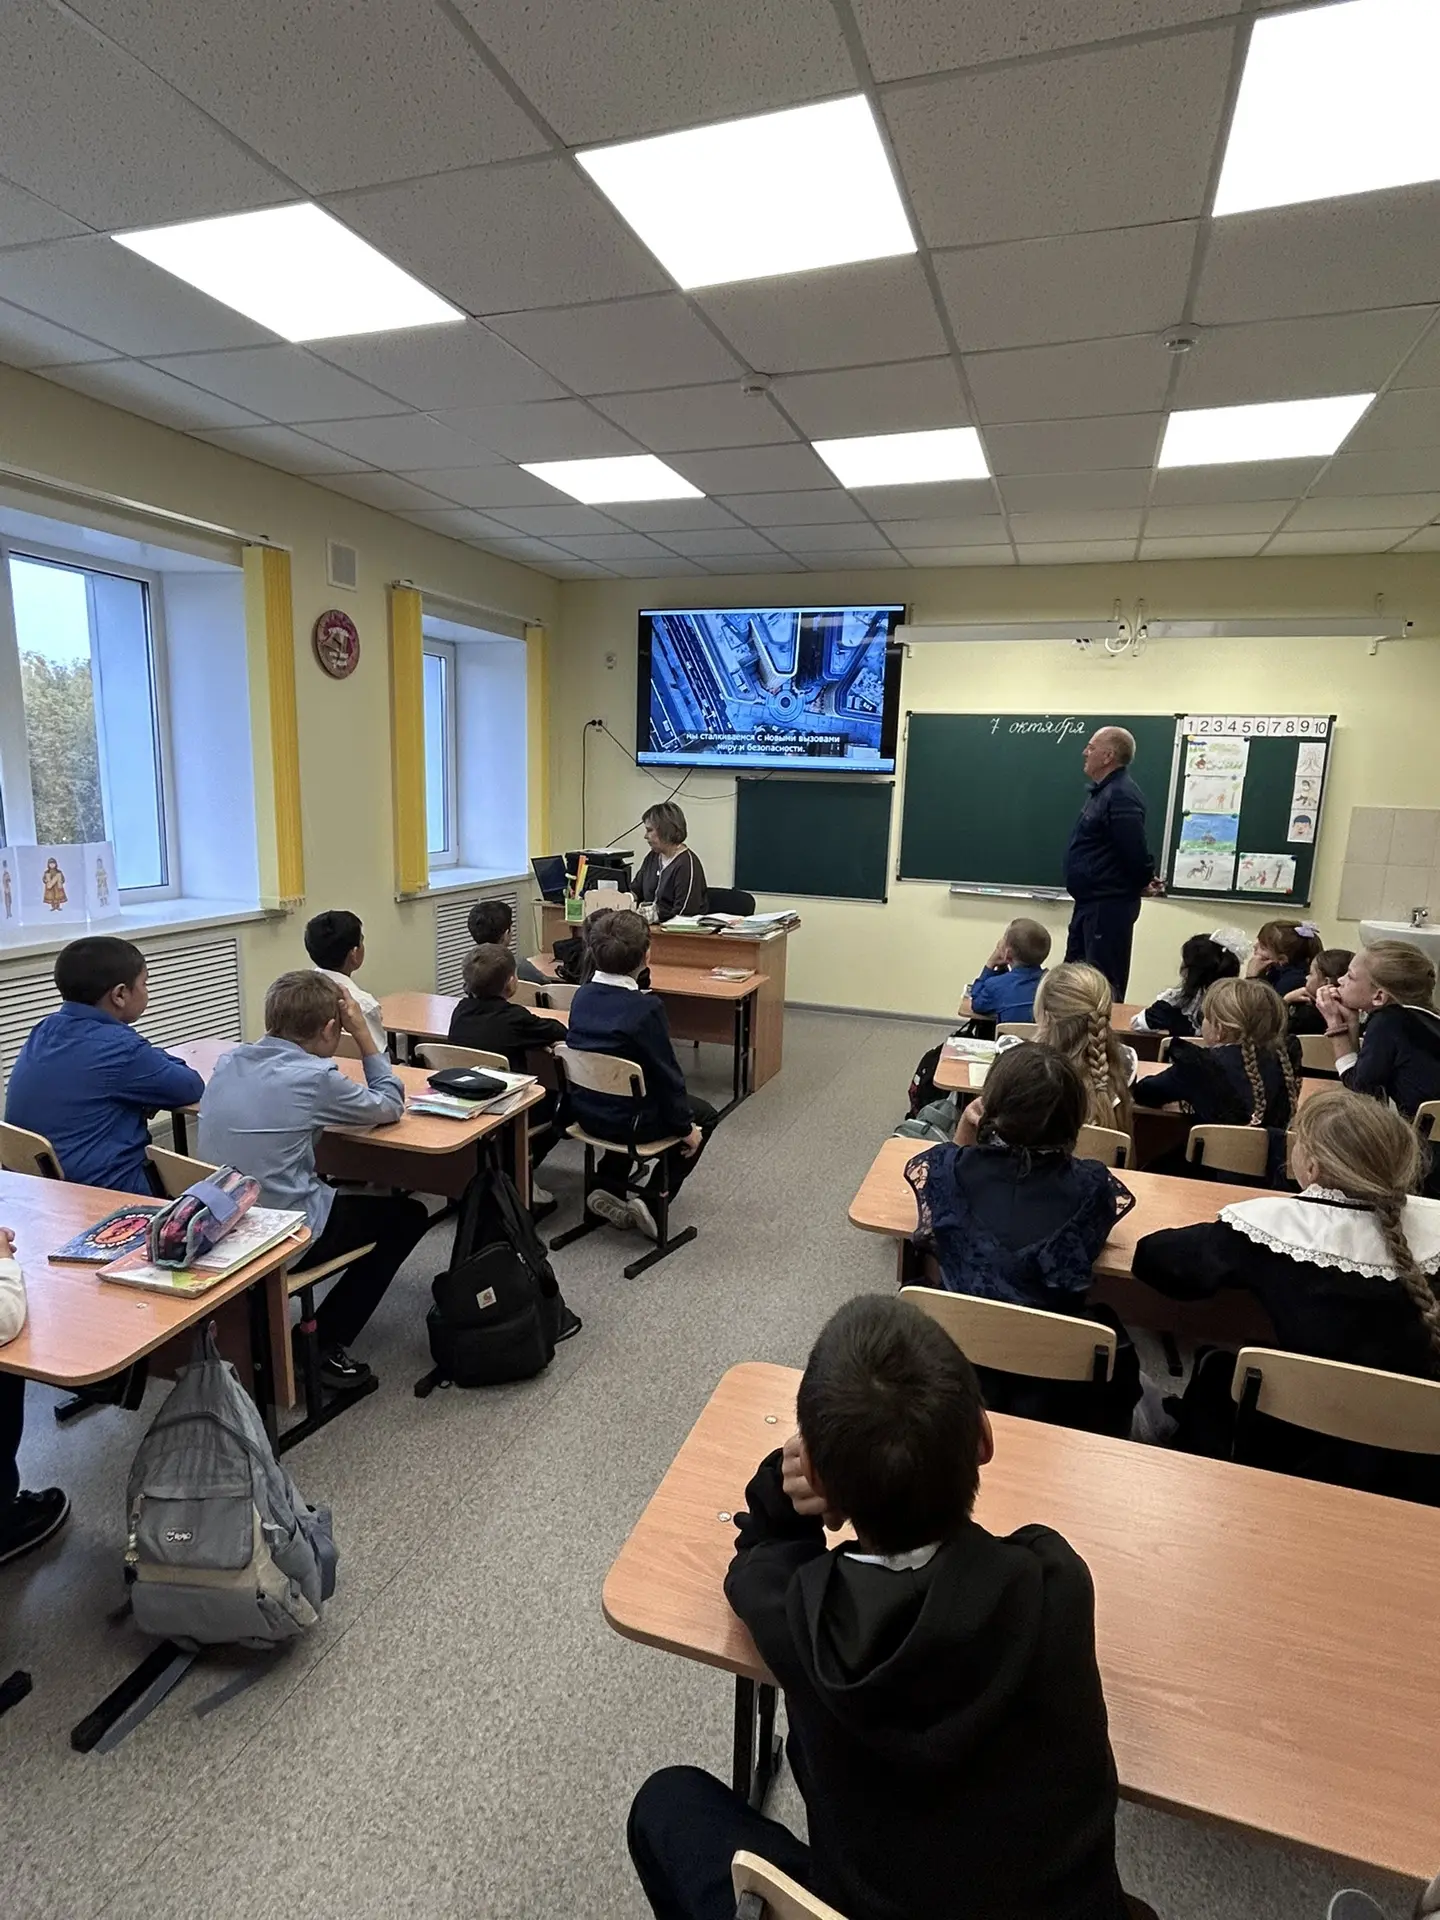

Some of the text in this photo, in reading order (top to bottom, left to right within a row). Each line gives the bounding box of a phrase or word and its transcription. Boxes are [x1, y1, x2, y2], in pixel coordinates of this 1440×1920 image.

[990, 715, 1086, 744] 7 октября
[1188, 720, 1327, 735] 1 2 3 4 5 6 7 8 9 10
[700, 733, 755, 741] сталкиваемся
[764, 733, 796, 742] новыми
[798, 734, 840, 744] вызовами
[717, 744, 735, 753] миру
[747, 744, 806, 754] безопасности.
